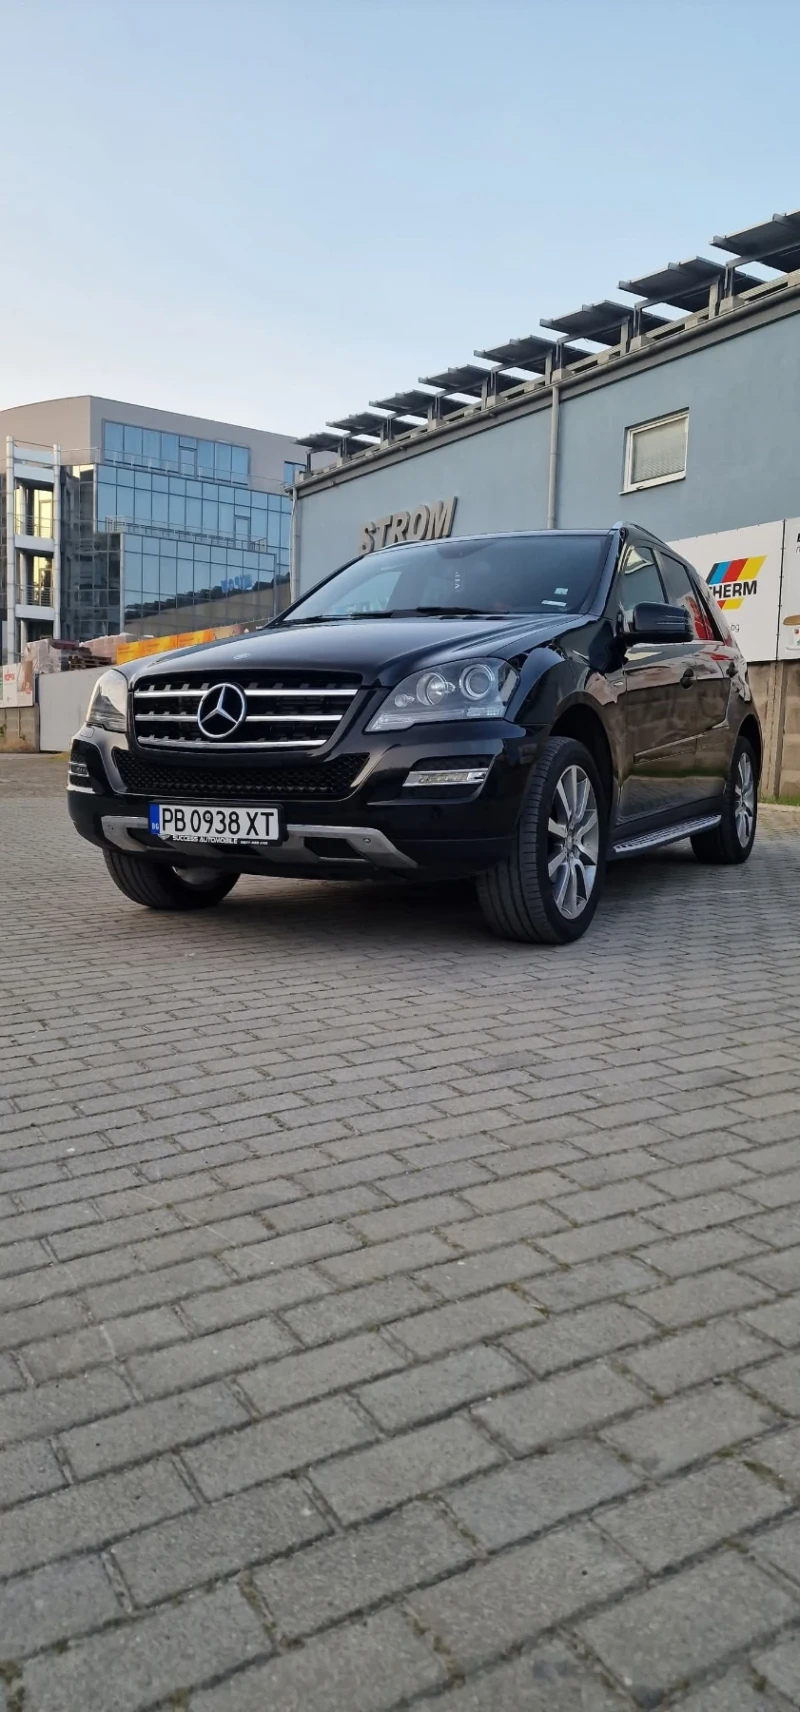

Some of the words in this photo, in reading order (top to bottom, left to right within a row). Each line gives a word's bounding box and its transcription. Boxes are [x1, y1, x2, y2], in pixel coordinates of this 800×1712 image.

[359, 496, 458, 553] STROM
[709, 580, 758, 599] HERM
[162, 808, 186, 831] PB
[190, 809, 240, 835] 0938
[246, 811, 274, 836] XT
